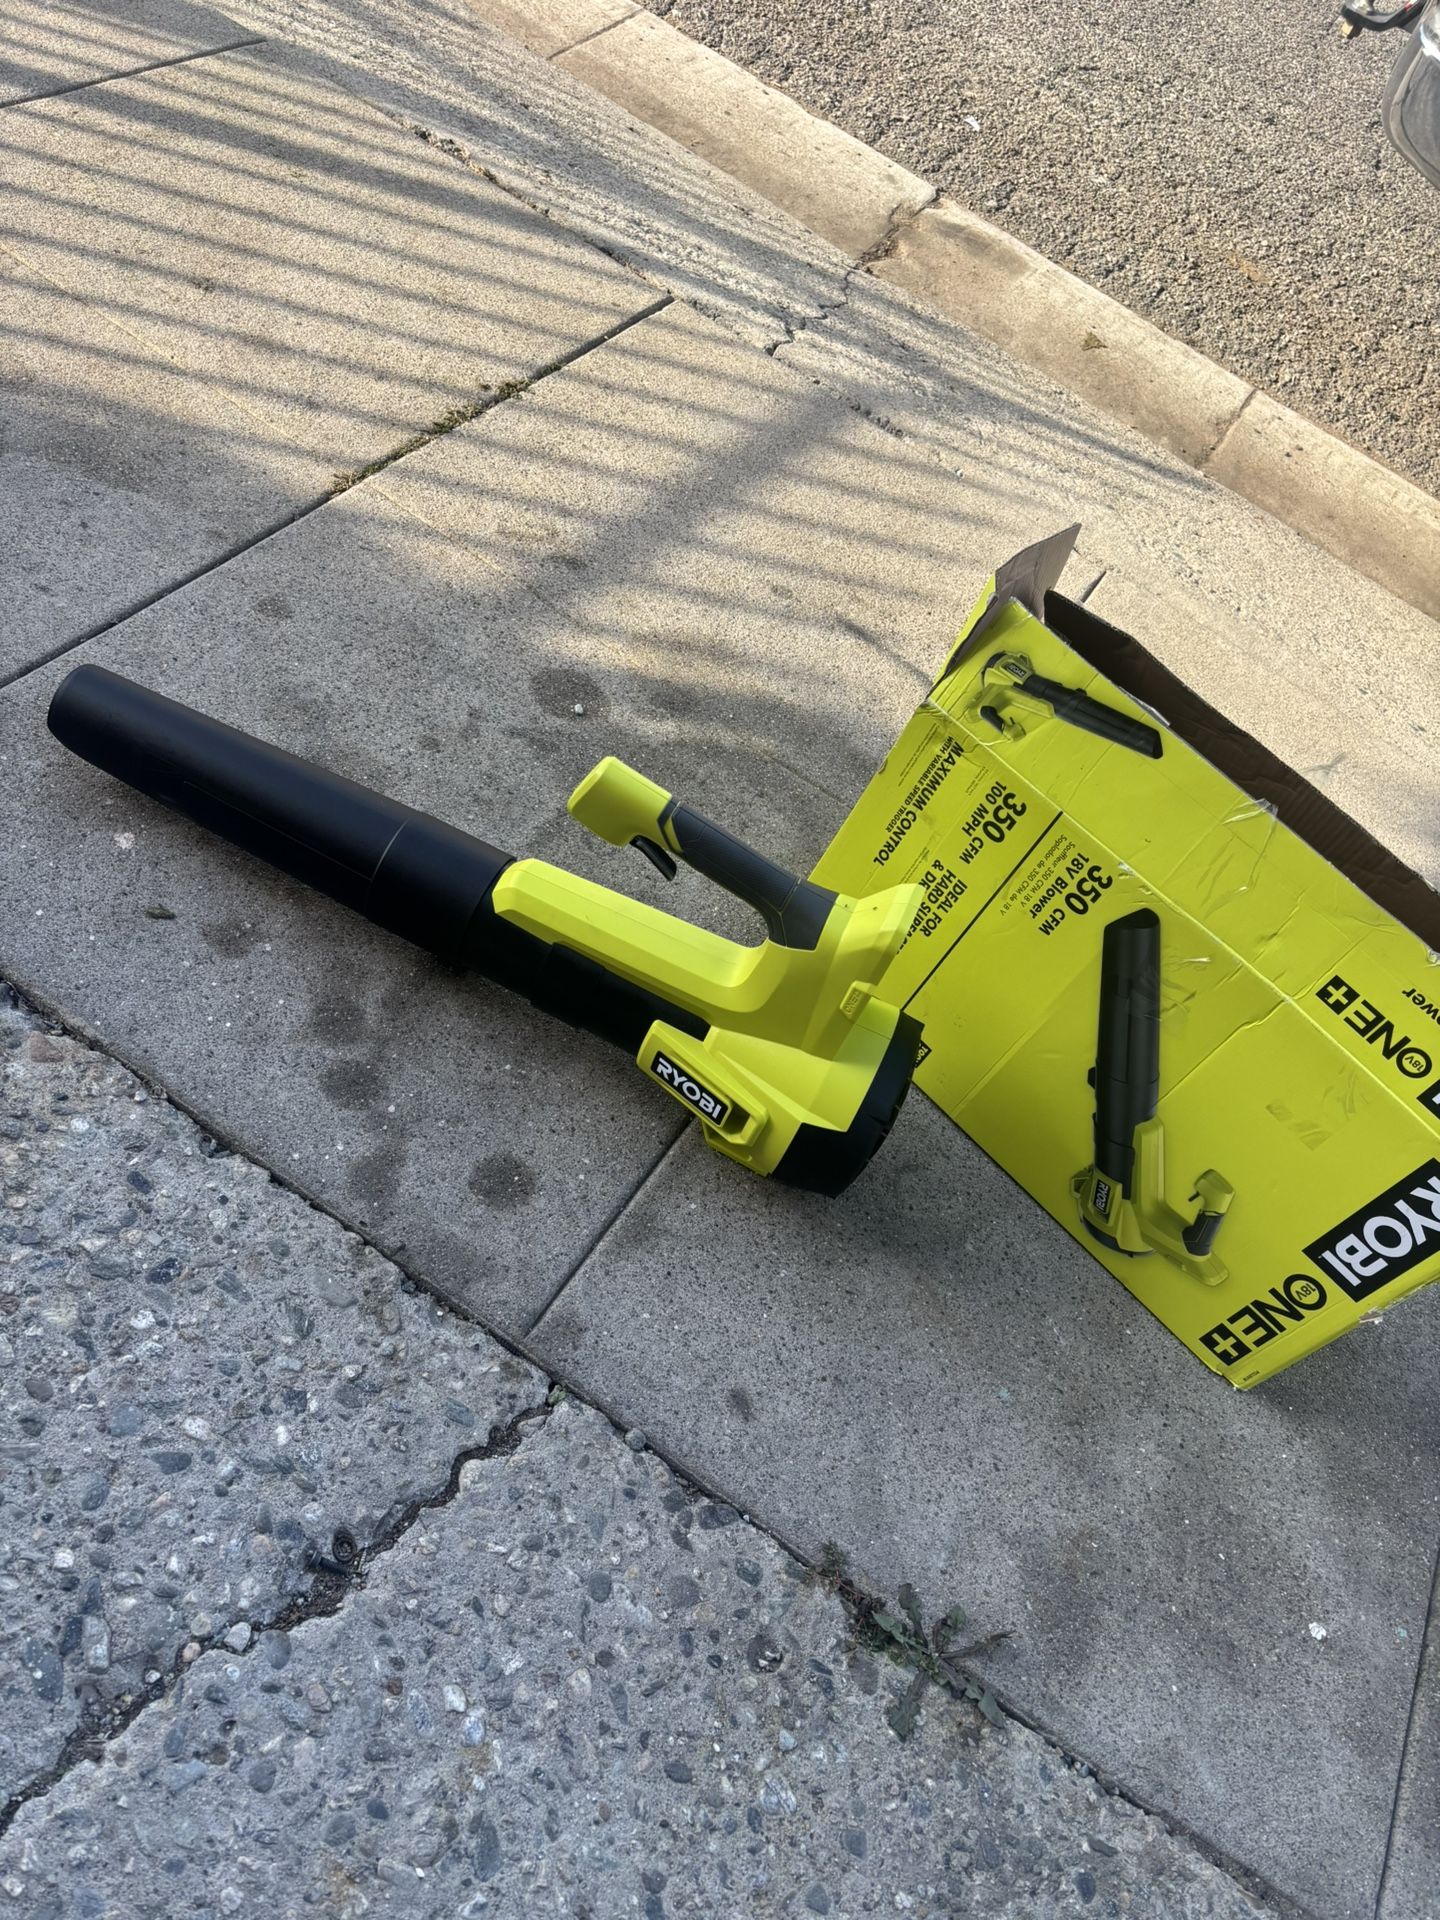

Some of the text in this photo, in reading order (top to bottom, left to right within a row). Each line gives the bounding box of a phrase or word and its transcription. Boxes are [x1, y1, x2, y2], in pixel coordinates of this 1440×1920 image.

[939, 735, 955, 755] WITH
[912, 740, 965, 812] MAXIMUM
[917, 754, 943, 787] VARIABLE
[904, 784, 921, 806] SPEED
[985, 781, 1007, 805] 100
[885, 805, 908, 833] TRIGGER
[959, 792, 1027, 865] 350 CFM
[961, 803, 990, 837] MPH
[873, 810, 917, 867] CONTROL
[1043, 834, 1068, 861] Soplador
[931, 859, 945, 872] &
[1036, 859, 1046, 869] de
[1051, 841, 1076, 868] Souffleur
[1026, 867, 1040, 882] 350
[1029, 852, 1090, 920] 18V Blower
[1041, 866, 1055, 881] 350
[927, 868, 957, 905] HARD
[1009, 892, 1018, 902] de
[1015, 880, 1030, 895] CFM
[1023, 893, 1033, 903] 18
[1029, 879, 1045, 894] CFM
[919, 879, 968, 937] IDEAL FOR
[1002, 901, 1013, 911] 18
[1038, 865, 1113, 936] 350 CFM
[1404, 1052, 1424, 1075] 18V
[656, 1057, 722, 1119] RYOBI
[1095, 1182, 1109, 1211] RYOBI
[1295, 1283, 1316, 1301] 18V
